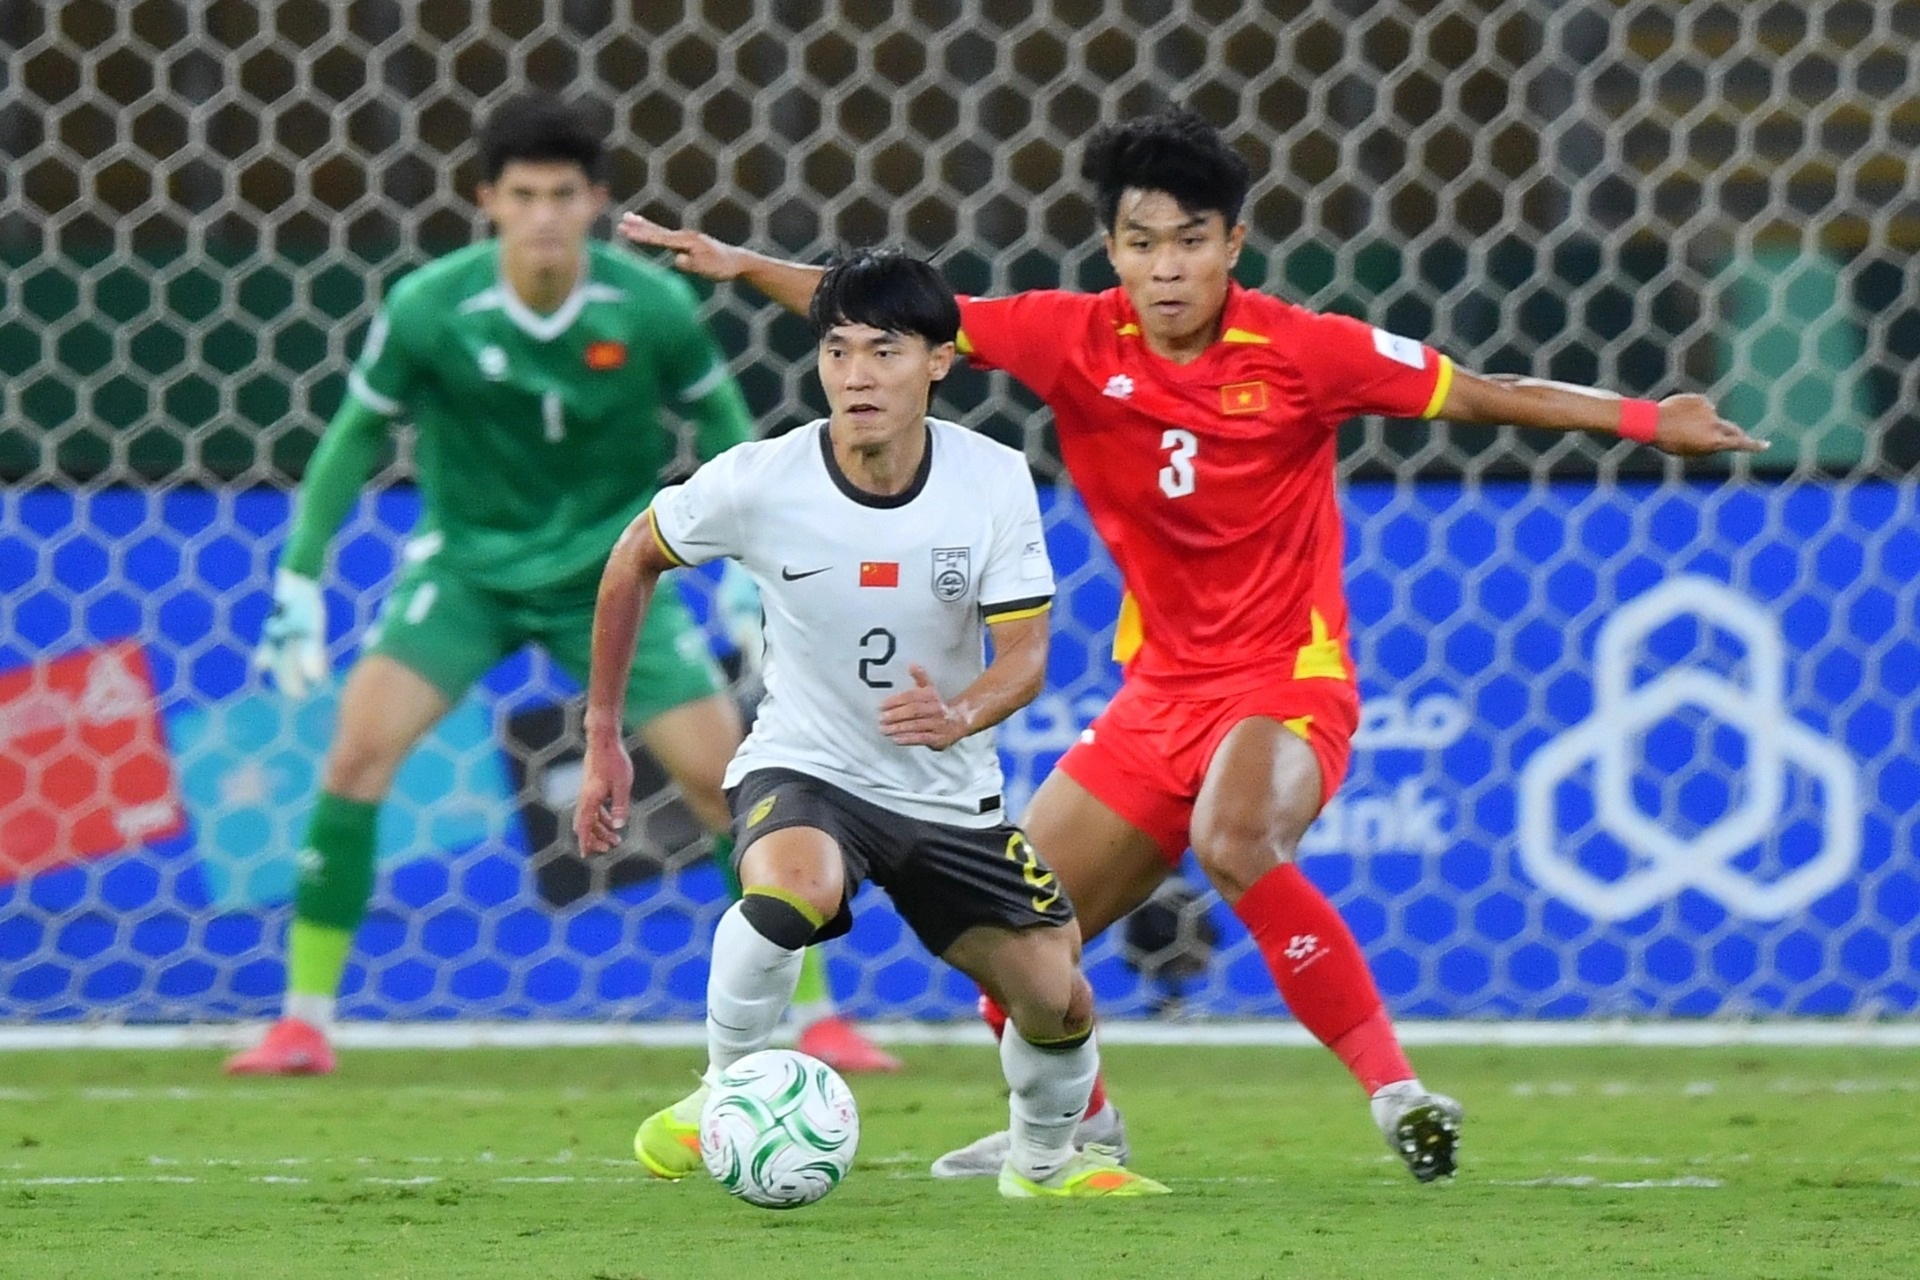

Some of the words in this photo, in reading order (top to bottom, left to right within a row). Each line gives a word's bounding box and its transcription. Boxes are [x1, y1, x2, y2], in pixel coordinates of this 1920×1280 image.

[1159, 429, 1198, 499] 3
[859, 627, 896, 689] 2
[1297, 777, 1448, 854] ank
